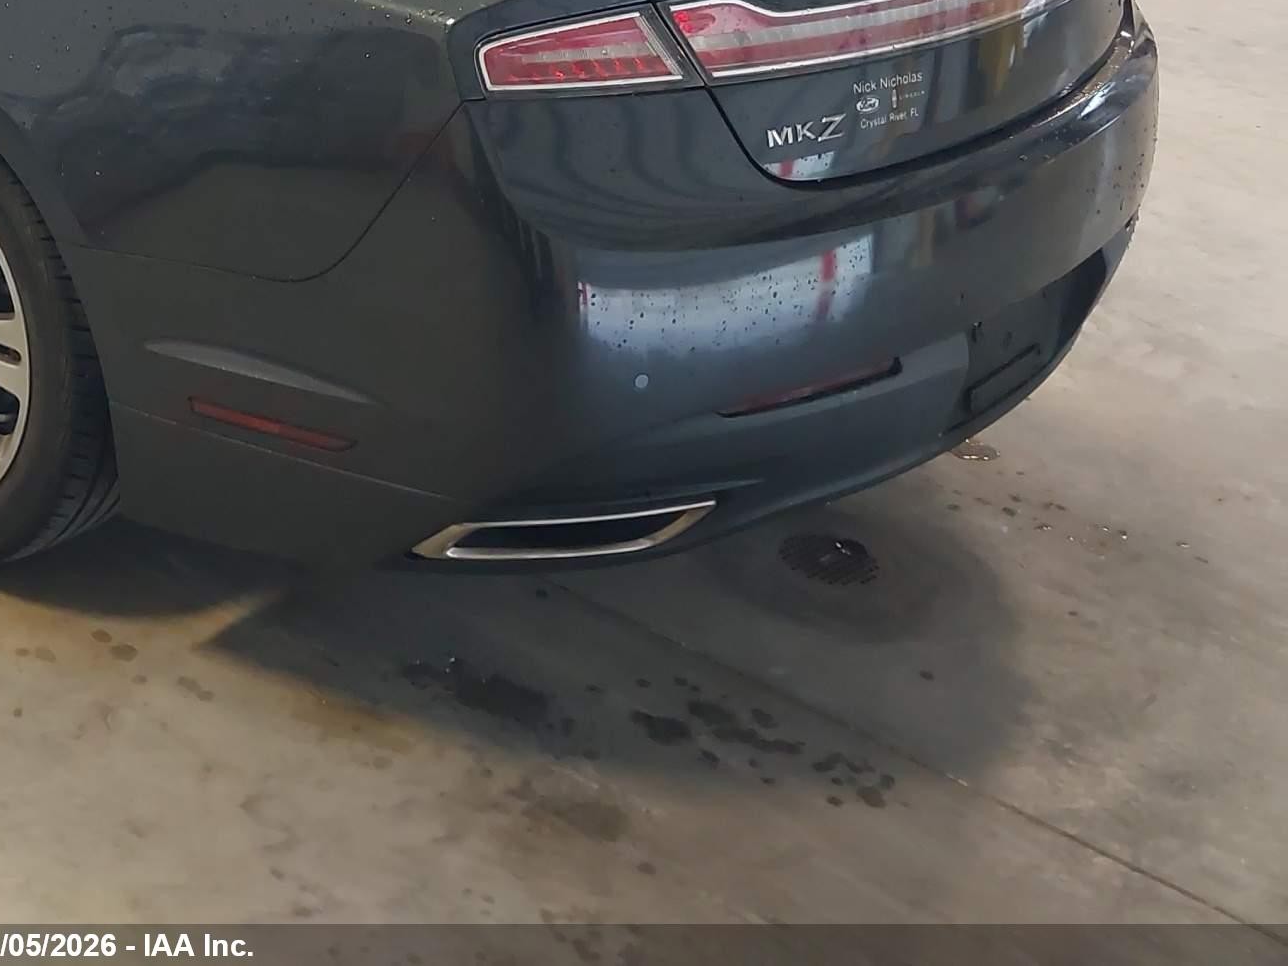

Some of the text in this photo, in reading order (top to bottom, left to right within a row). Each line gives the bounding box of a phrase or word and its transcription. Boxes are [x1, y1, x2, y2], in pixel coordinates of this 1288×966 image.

[853, 71, 923, 94] Nick Nicholas
[766, 113, 847, 148] MKZ
[861, 116, 887, 129] Crystal
